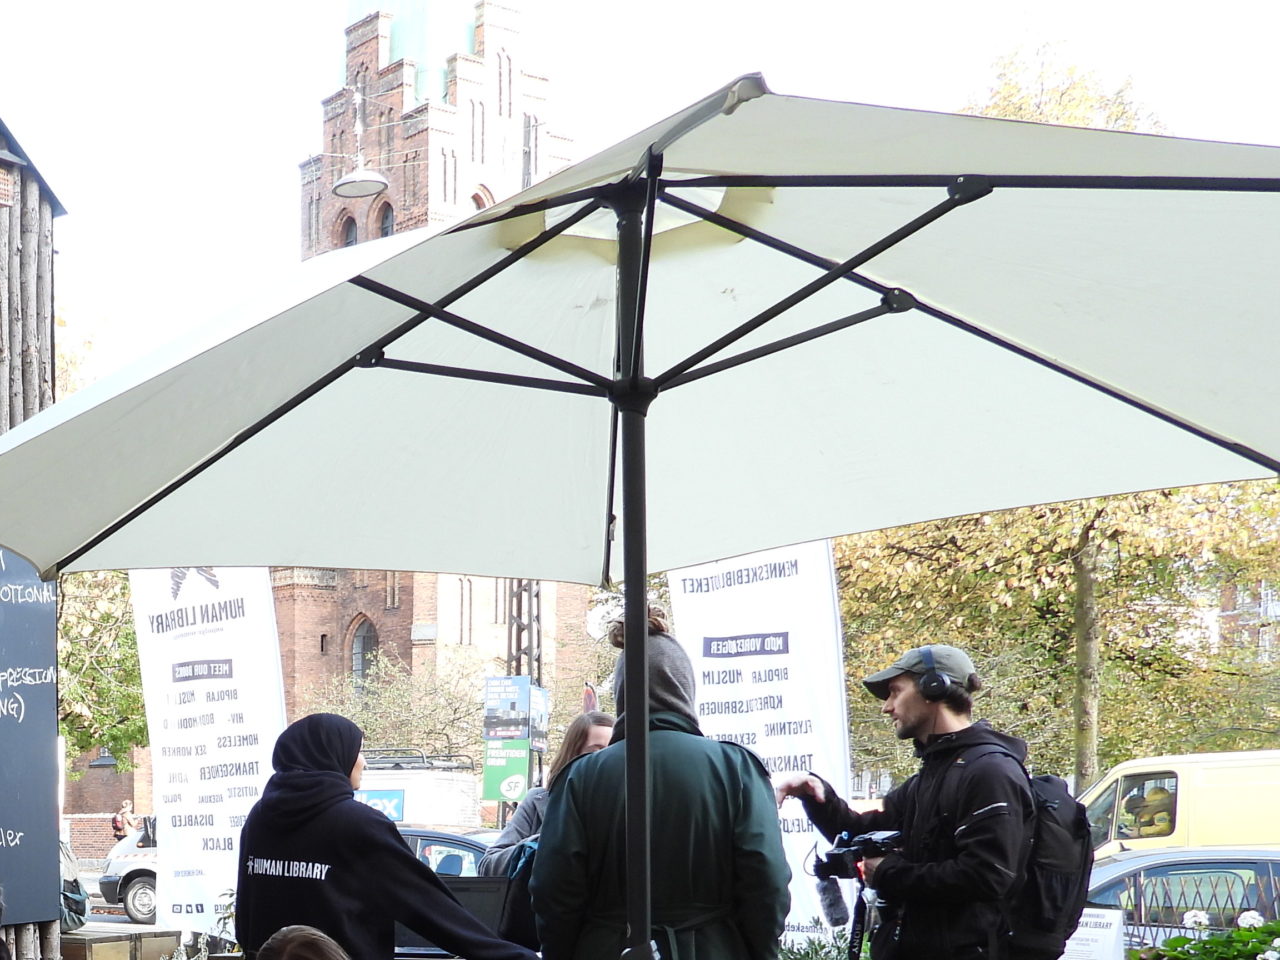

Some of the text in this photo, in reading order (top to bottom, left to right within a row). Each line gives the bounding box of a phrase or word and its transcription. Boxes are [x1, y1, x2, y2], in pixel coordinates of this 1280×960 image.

[505, 781, 520, 792] SF
[253, 858, 329, 880] HUMAN LIBRARY
